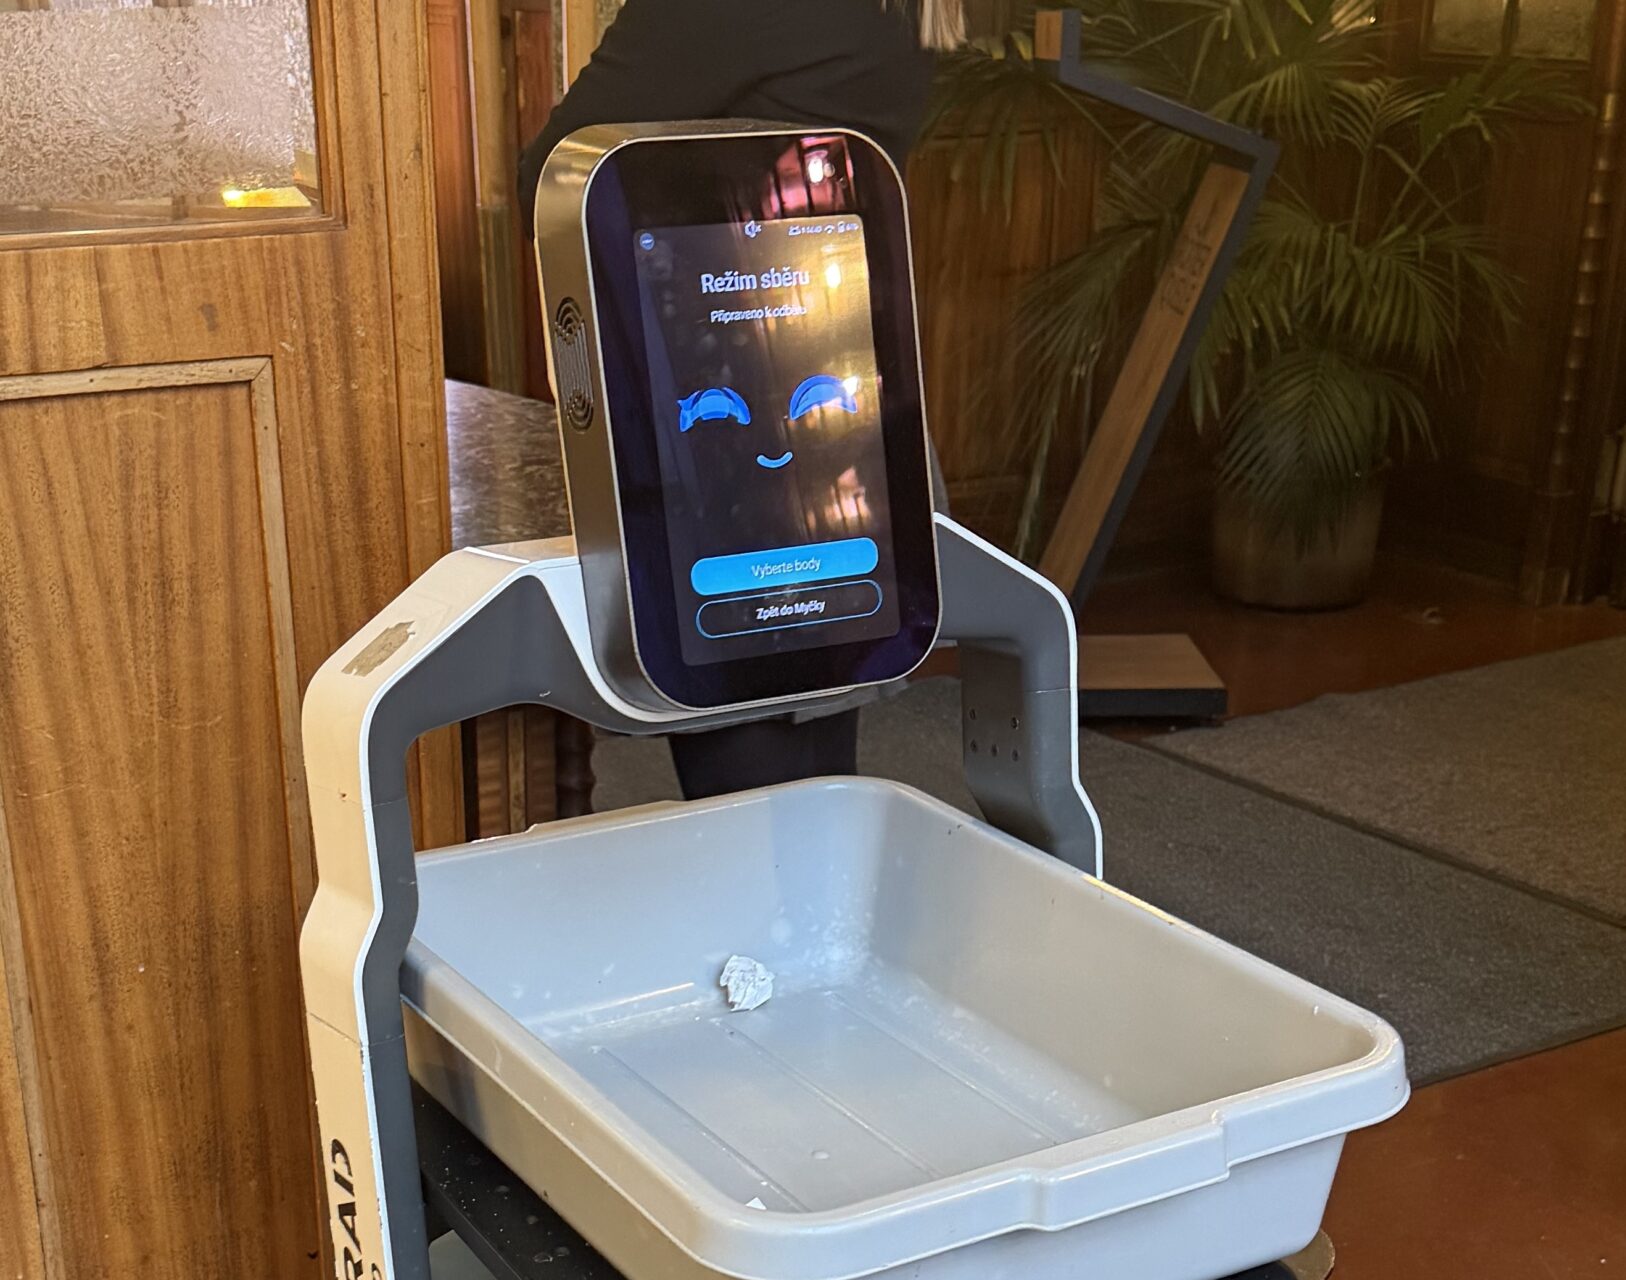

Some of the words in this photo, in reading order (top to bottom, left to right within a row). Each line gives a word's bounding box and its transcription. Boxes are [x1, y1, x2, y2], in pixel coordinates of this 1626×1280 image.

[700, 270, 757, 294] Režim
[761, 265, 810, 289] sběru
[710, 310, 764, 324] Připraveno
[751, 563, 793, 579] Vyberte
[795, 557, 821, 572] body
[780, 604, 795, 617] do
